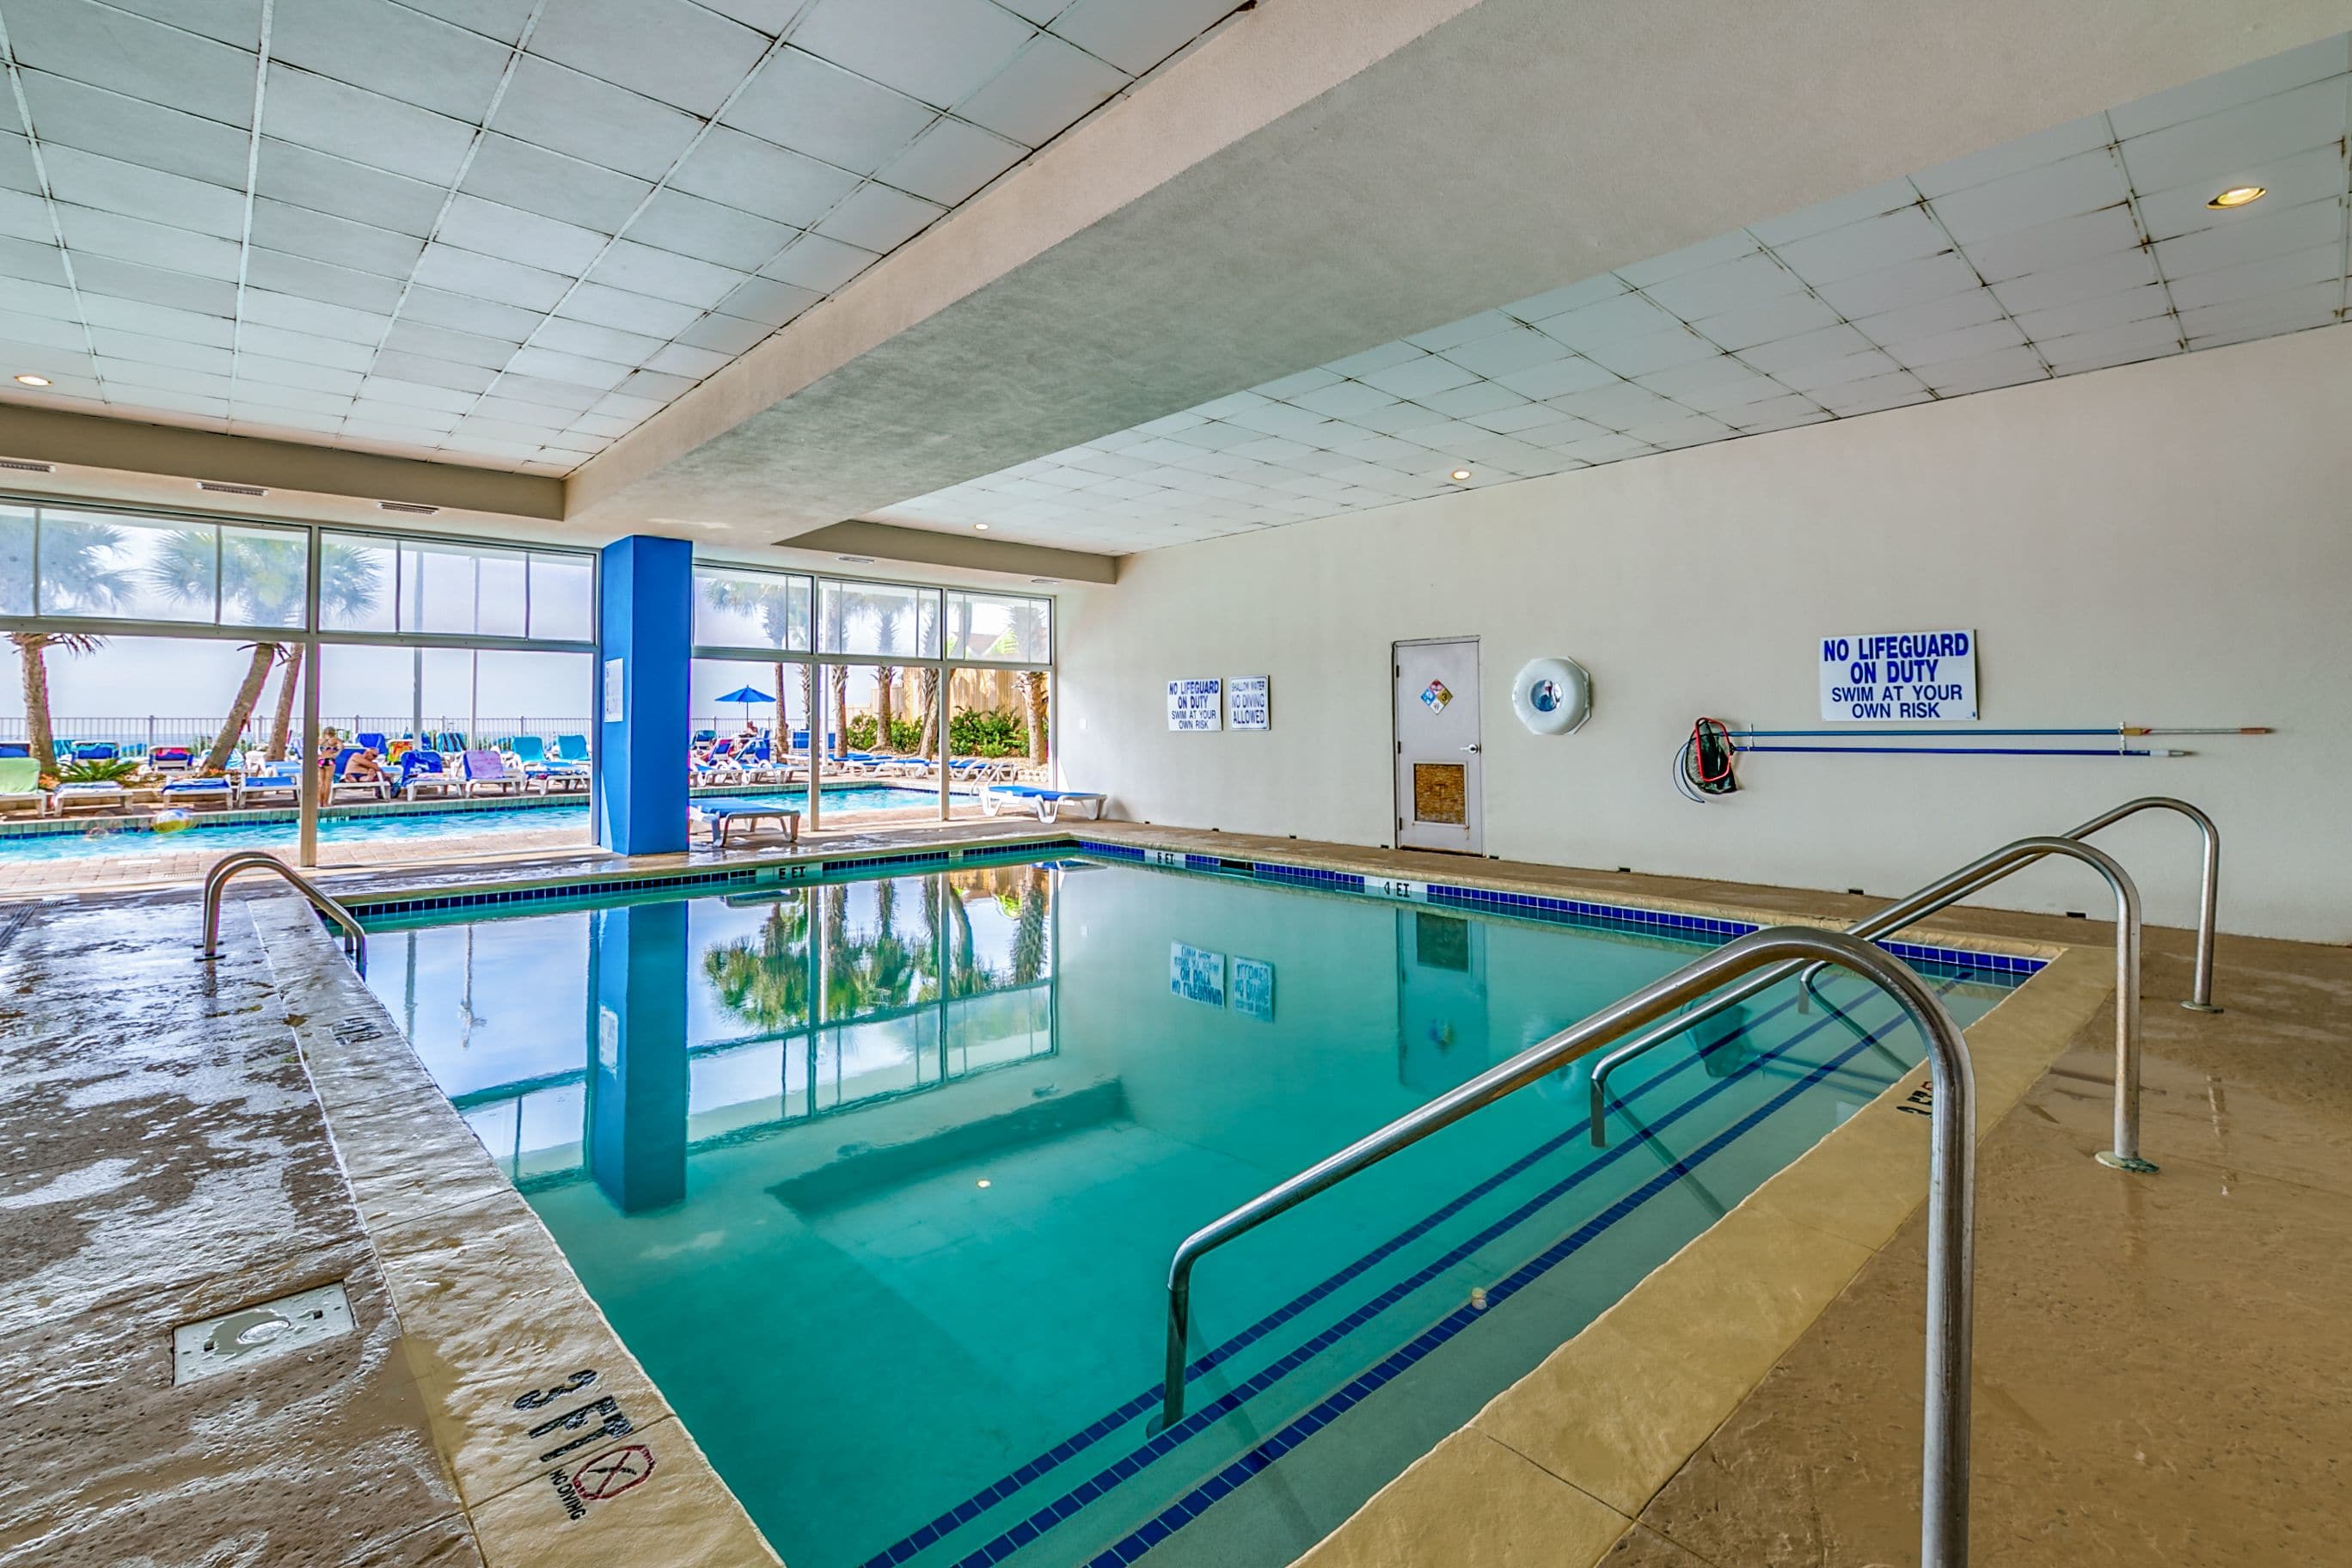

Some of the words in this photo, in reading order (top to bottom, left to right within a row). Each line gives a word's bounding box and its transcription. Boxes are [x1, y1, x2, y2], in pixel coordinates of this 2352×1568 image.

[1823, 639, 1849, 661] NO
[1859, 633, 1969, 660] LIFEGUARD
[1850, 661, 1877, 684] ON
[1887, 658, 1939, 683] DUTY
[1169, 683, 1178, 695] NO
[1180, 680, 1219, 695] LIFEGUARD
[1832, 687, 1873, 701] SWIM
[1882, 685, 1904, 701] AT
[1913, 684, 1963, 701] YOUR
[1178, 696, 1187, 709] ON
[1190, 695, 1209, 708] DUTY
[1231, 695, 1240, 708] NO
[1171, 711, 1186, 720] SWIM
[1189, 710, 1197, 720] AT
[1198, 710, 1216, 720] YOUR
[1233, 709, 1265, 724] ALLOWED
[1852, 703, 1890, 719] OWN
[1900, 702, 1940, 718] RISK
[1179, 720, 1193, 730] OWN
[1195, 720, 1209, 729] RISK
[513, 1369, 597, 1411] 3
[528, 1394, 634, 1461] FT
[557, 1484, 586, 1521] DIVING
